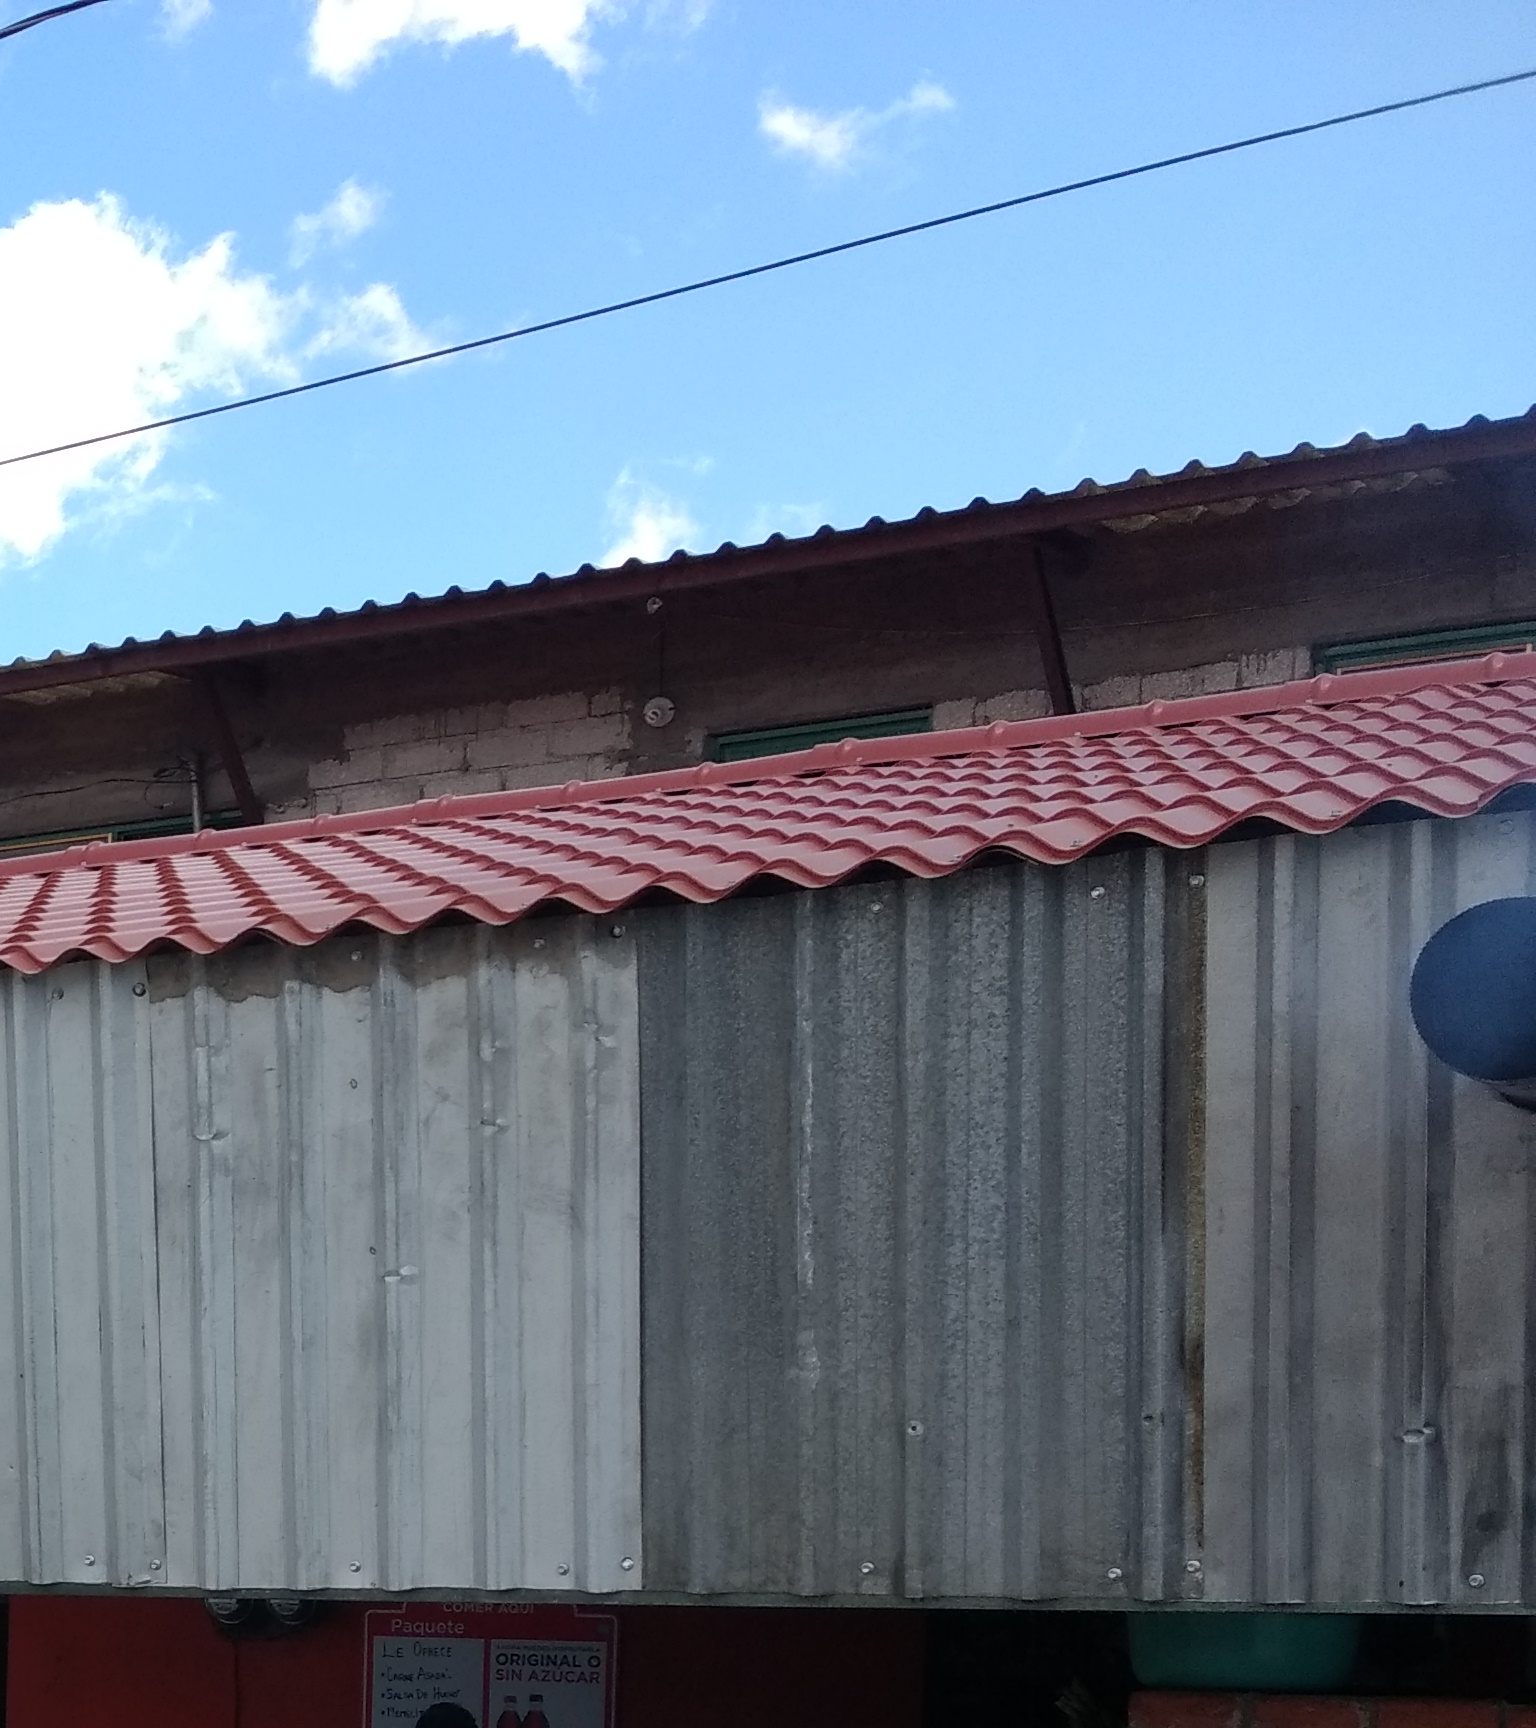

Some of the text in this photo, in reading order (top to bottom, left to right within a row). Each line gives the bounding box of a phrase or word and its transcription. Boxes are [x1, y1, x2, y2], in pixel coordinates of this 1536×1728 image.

[443, 1602, 494, 1613] COMER
[390, 1618, 465, 1635] Paquete
[495, 1653, 601, 1668] ORIGINAL O
[495, 1667, 600, 1684] SIN AZÚCAR
